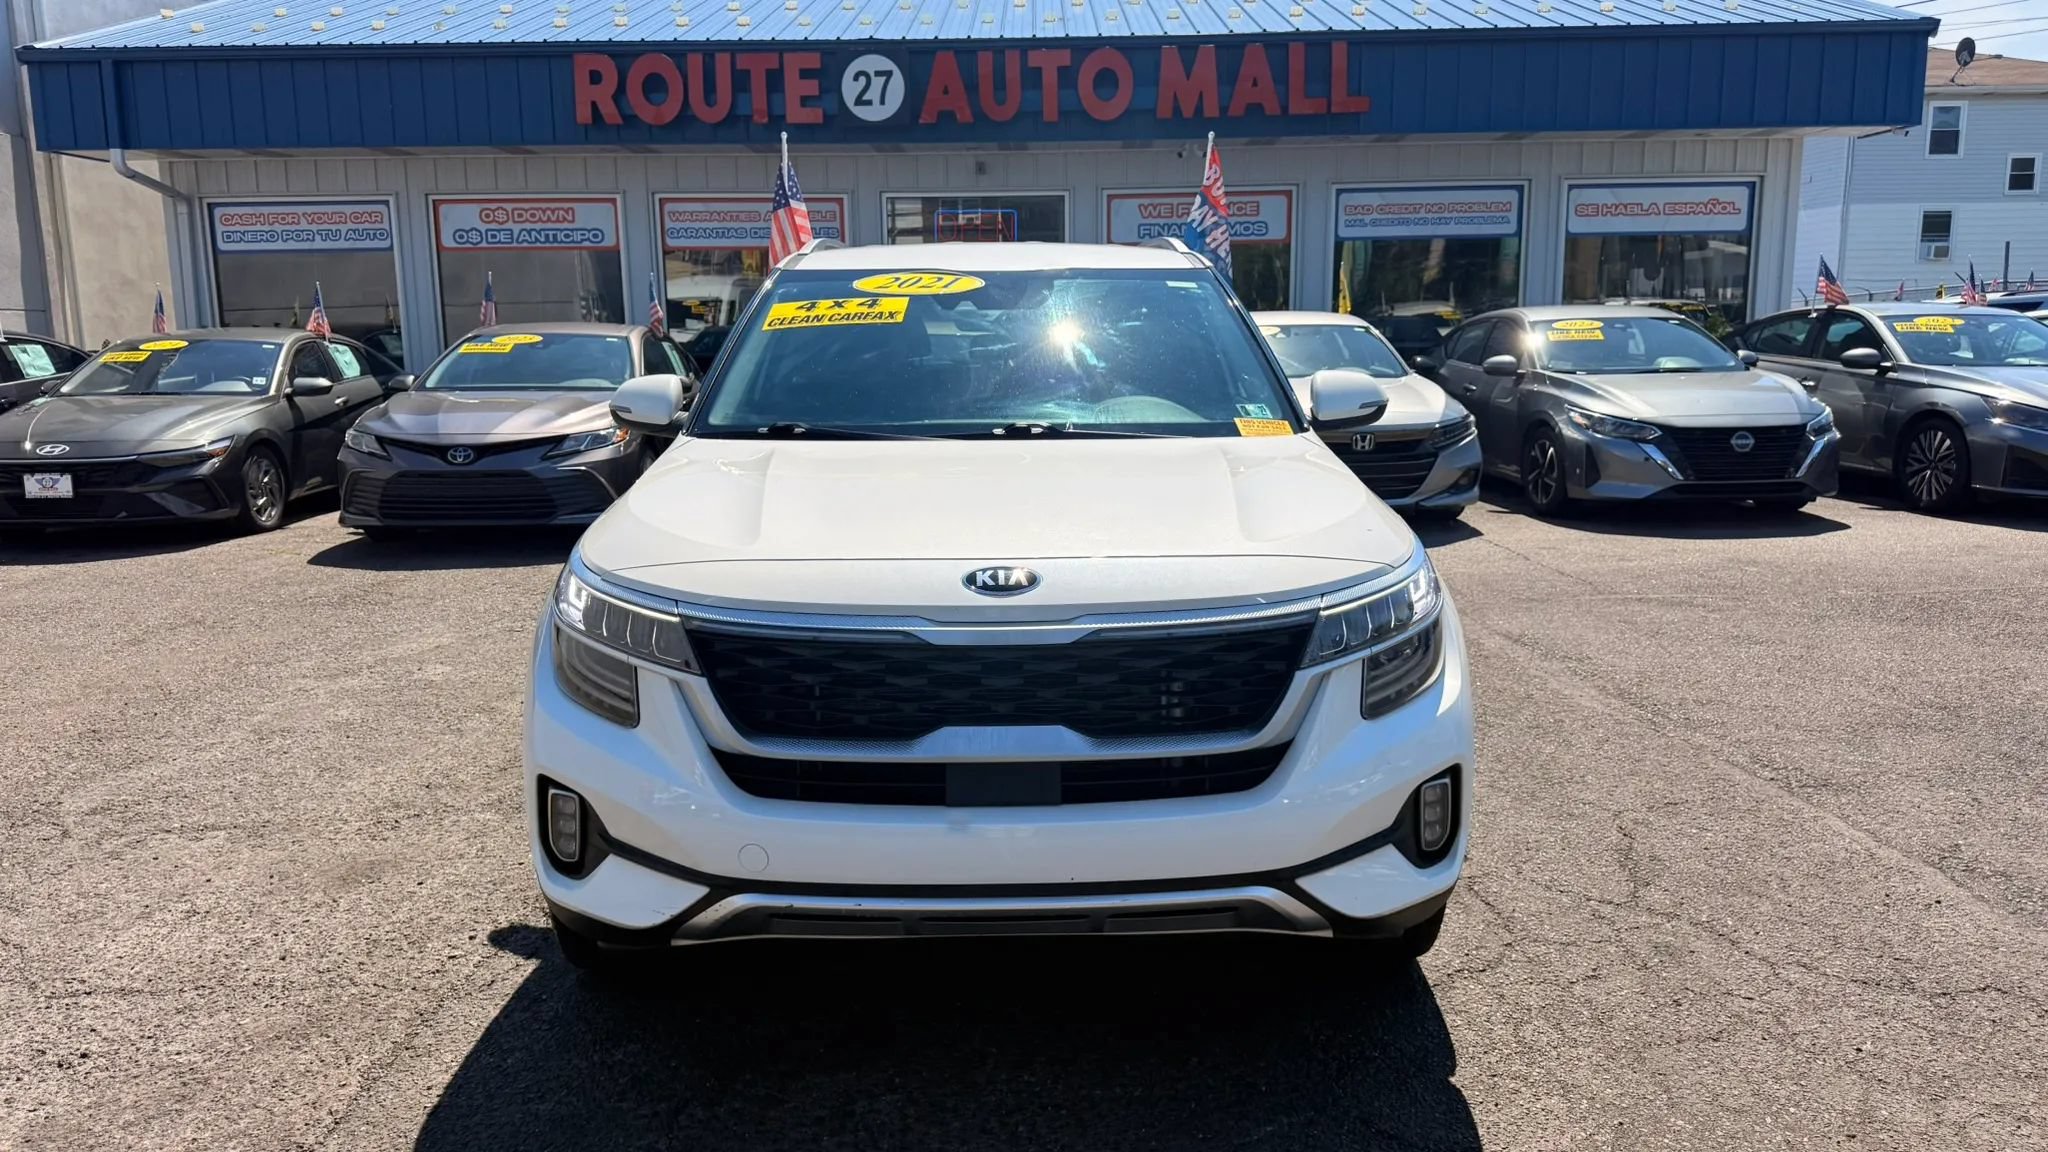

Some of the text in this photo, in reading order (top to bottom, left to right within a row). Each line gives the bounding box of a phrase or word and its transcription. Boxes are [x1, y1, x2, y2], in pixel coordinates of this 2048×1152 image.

[573, 40, 1371, 126] ROUTE 27 AUTO MALL
[512, 207, 575, 224] DOWN
[1138, 201, 1260, 218] WE FNCE
[1344, 201, 1512, 216] BAD CREDIT NO PROBLEM
[1575, 198, 1741, 217] SE HABLA ESPAÑOL
[221, 211, 384, 227] CASH FOR YOUR CAR
[668, 210, 761, 223] WARRANTIES
[1344, 215, 1511, 227] MAL CREDITO NO HAY PROBLEMA
[222, 228, 389, 243] DINERO POR TU AUTO
[666, 226, 840, 239] GARANTIAS DISLES
[937, 213, 1015, 242] OPEN
[1138, 221, 1268, 238] FINAMOS
[485, 229, 515, 244] DE
[516, 228, 606, 244] ANTICIPO
[878, 276, 962, 290] 2021
[795, 299, 819, 312] 4
[857, 298, 882, 310] 4
[767, 310, 903, 328] CLEAN CARFAX
[975, 568, 1029, 587] KIA
